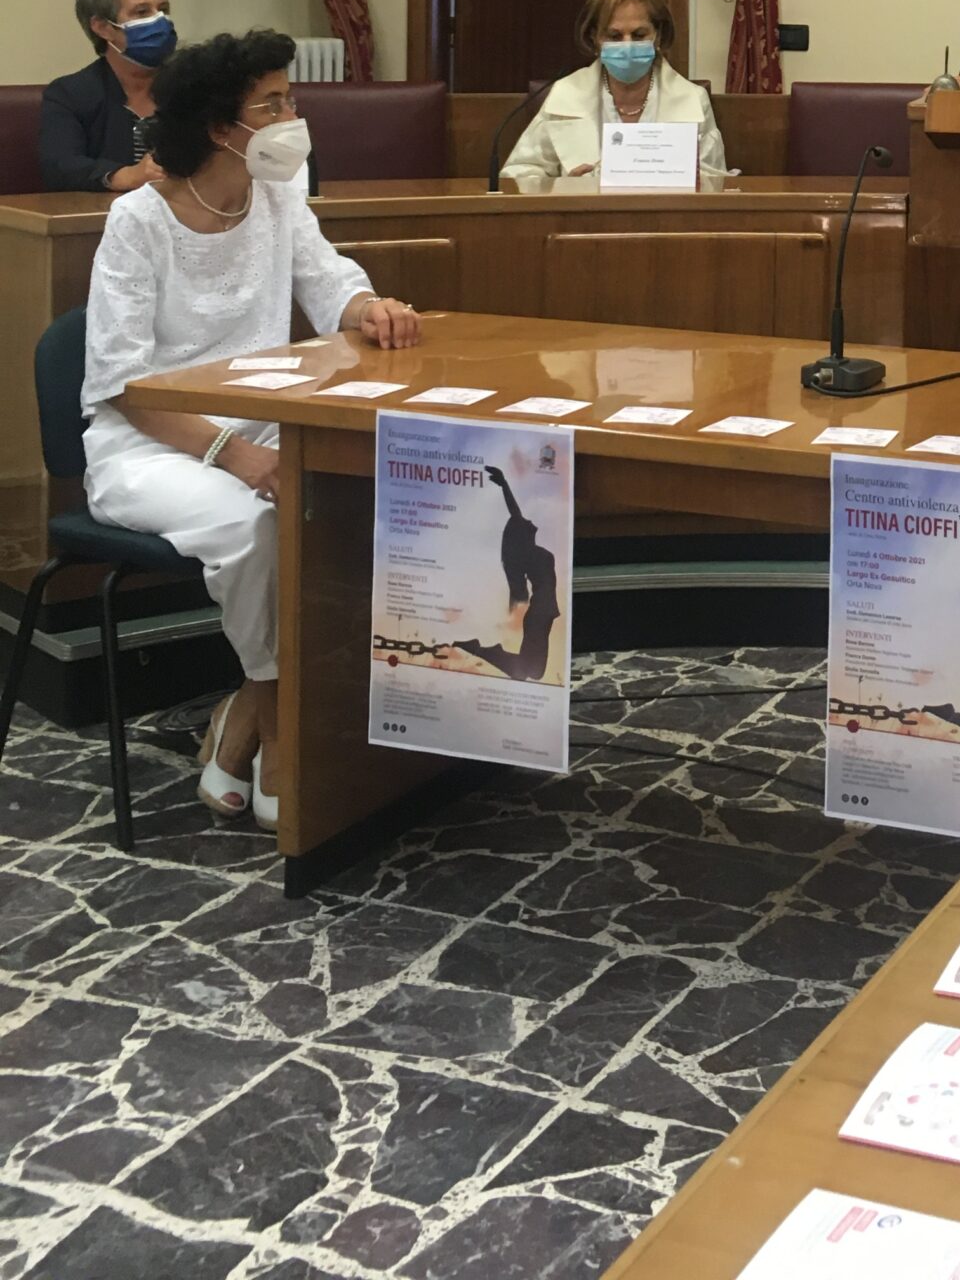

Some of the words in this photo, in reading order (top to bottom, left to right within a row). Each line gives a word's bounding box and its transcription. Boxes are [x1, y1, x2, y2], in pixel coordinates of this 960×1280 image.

[387, 442, 420, 457] Centro
[423, 448, 484, 464] antiviolenza
[387, 460, 433, 482] TITINA
[438, 466, 483, 488] CIOFFI
[845, 489, 883, 507] Centro
[888, 495, 960, 513] antiviolenza
[845, 508, 900, 532] TITINA
[904, 515, 958, 539] CIOFFI
